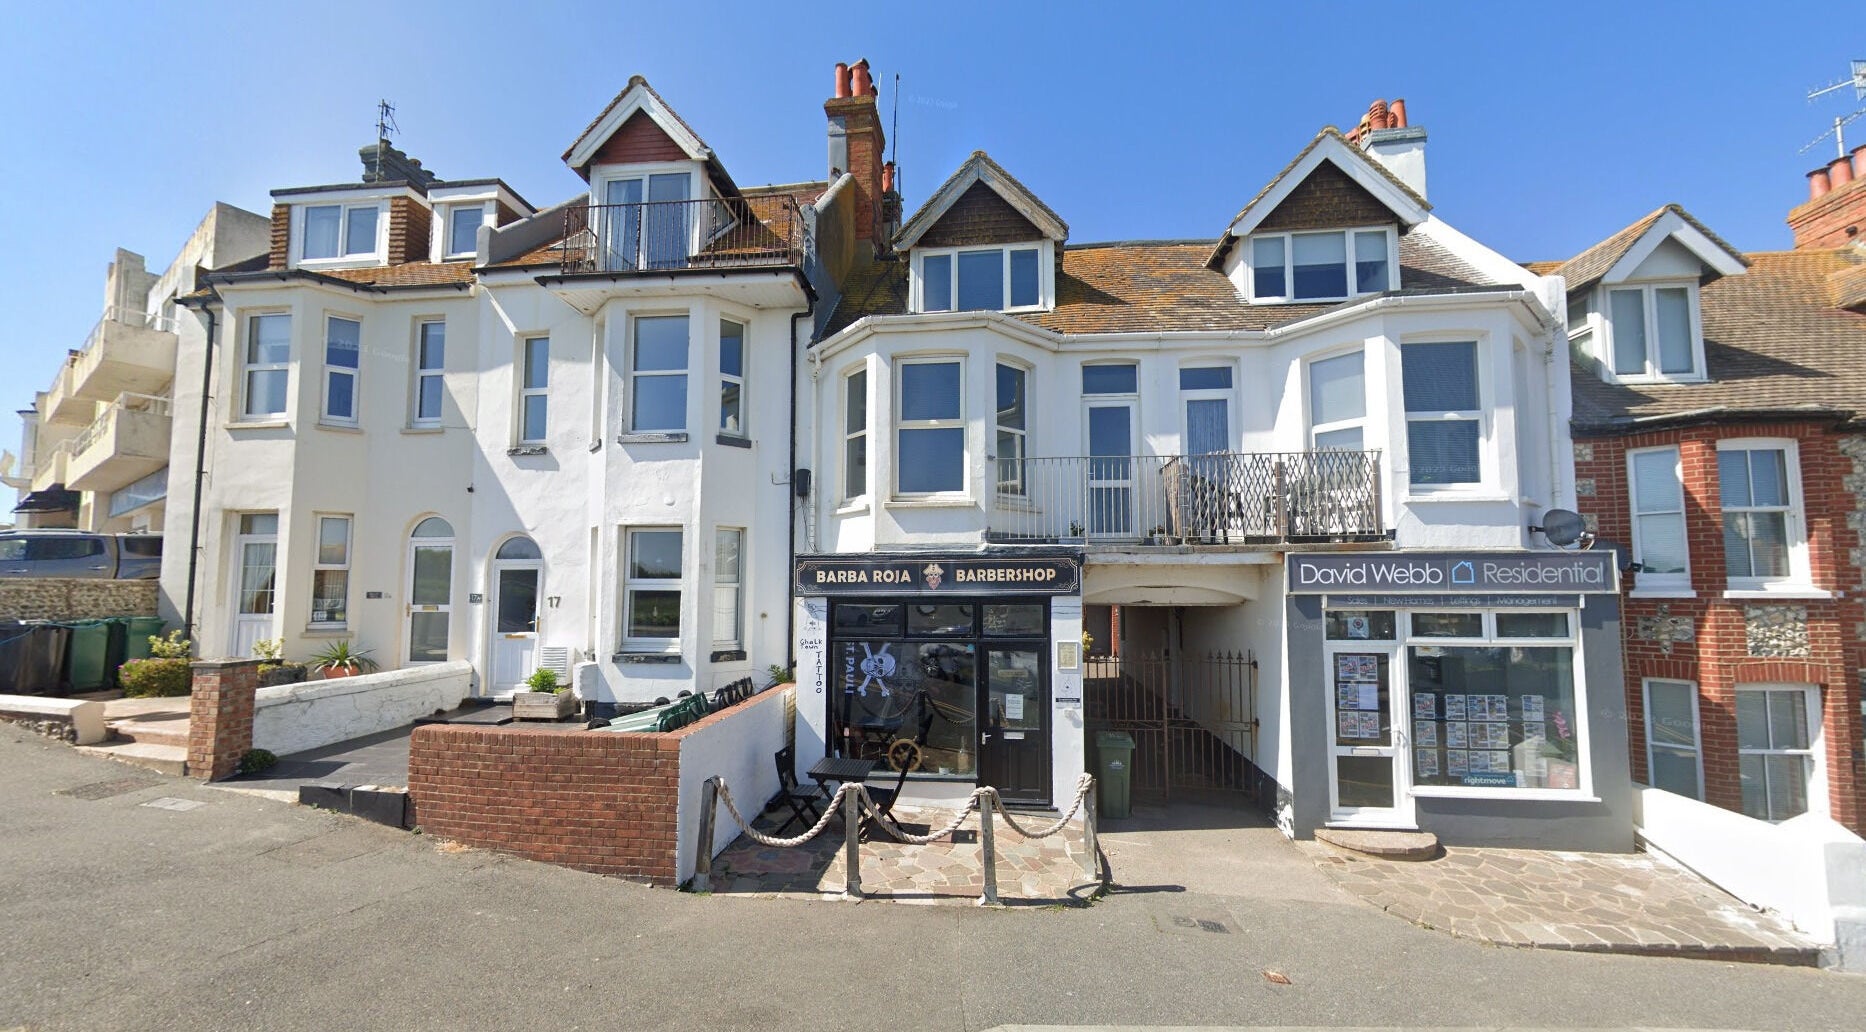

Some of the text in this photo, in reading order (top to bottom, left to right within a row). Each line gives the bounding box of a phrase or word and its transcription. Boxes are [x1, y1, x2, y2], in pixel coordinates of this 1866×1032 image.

[816, 569, 912, 584] BARBA ROJA
[956, 568, 1056, 582] BARBERSHOP
[1300, 562, 1443, 584] David Webb
[1483, 561, 1604, 584] Residential
[547, 596, 561, 608] 17
[1347, 596, 1368, 605] Sales
[1496, 596, 1558, 606] Management
[846, 657, 854, 693] PAULI
[1464, 776, 1506, 785] rightmove
